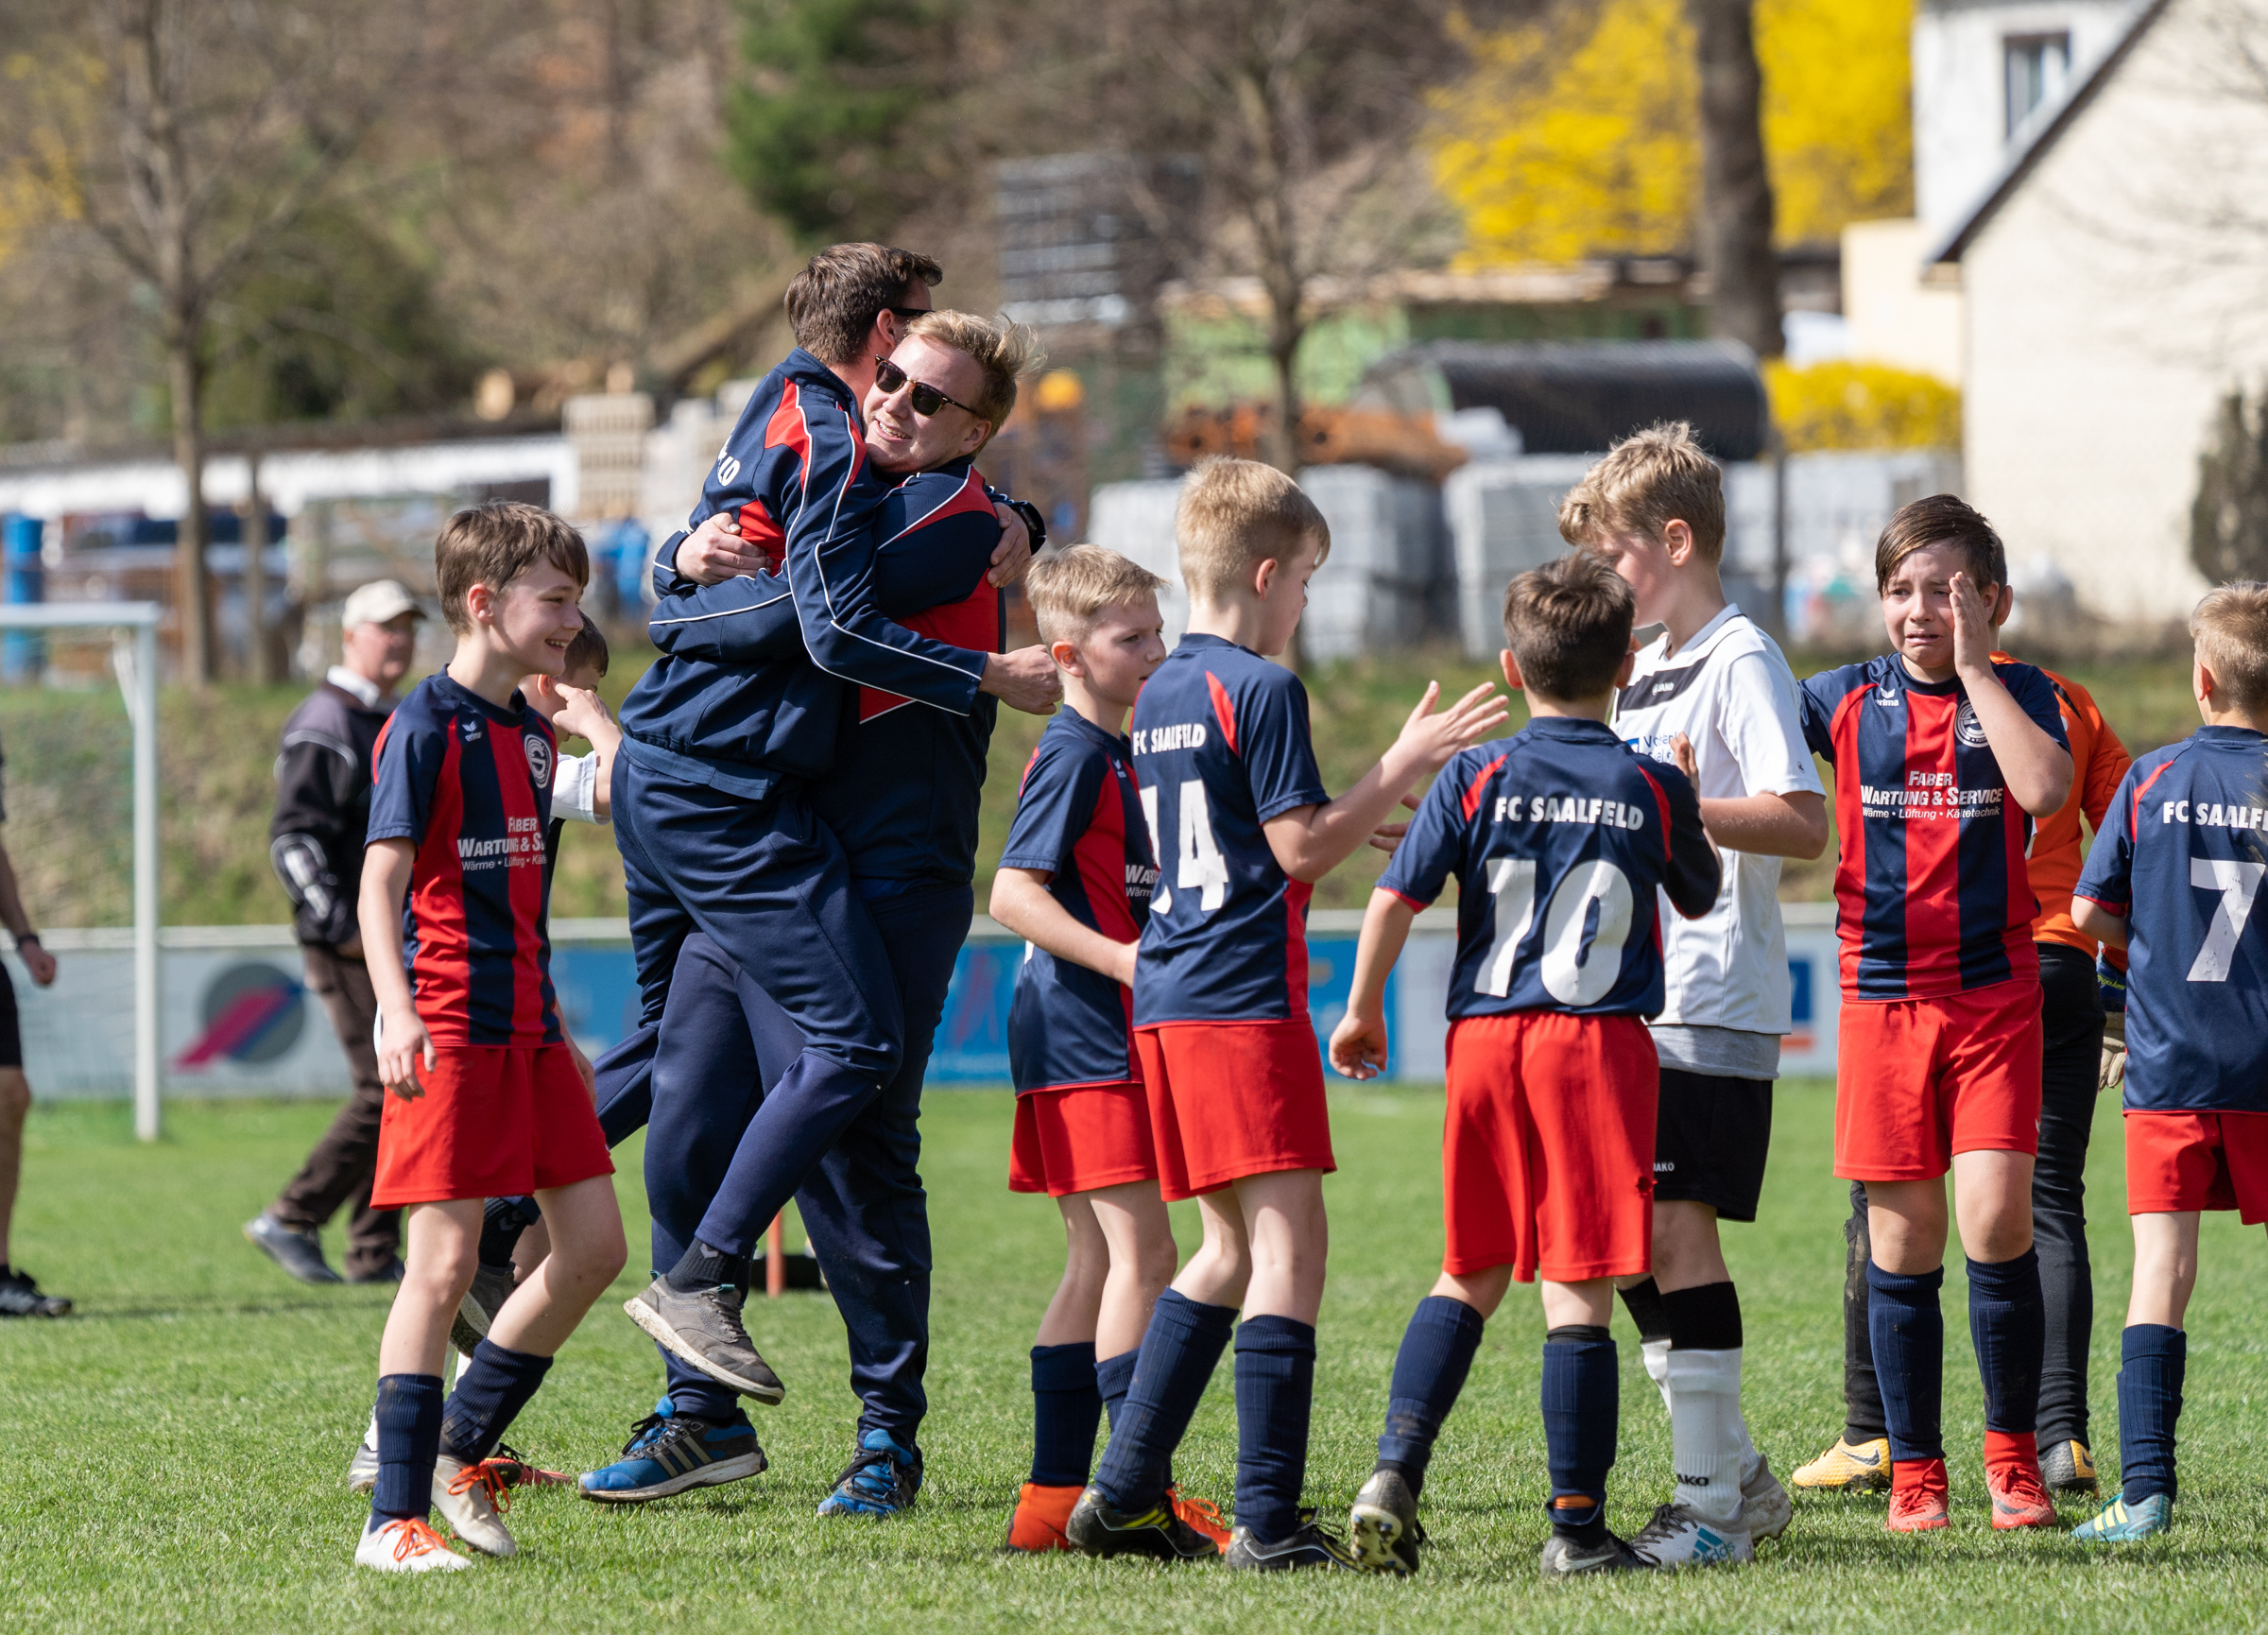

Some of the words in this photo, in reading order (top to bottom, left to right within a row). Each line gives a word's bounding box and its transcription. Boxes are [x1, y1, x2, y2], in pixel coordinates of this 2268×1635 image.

[1133, 729, 1147, 756] FC
[1150, 723, 1207, 753] SAALFELD
[1908, 770, 1953, 786] FABER
[1861, 785, 1930, 805] WARTUNG
[1931, 791, 1943, 805] &
[1946, 786, 2003, 805] SERVICE
[1494, 795, 1522, 822] FC
[1529, 795, 1644, 831] SAALFELD
[1863, 806, 1890, 818] Wärme
[1899, 808, 1936, 821] Lüftung
[1946, 806, 2001, 819] Kältetechnik
[2163, 800, 2189, 824] FC
[1139, 779, 1228, 915] 14
[461, 858, 495, 871] Wärme
[1125, 886, 1153, 898] Wärm
[2186, 856, 2266, 982] 7
[1473, 857, 1635, 1007] 10
[1676, 1474, 1710, 1487] AKO
